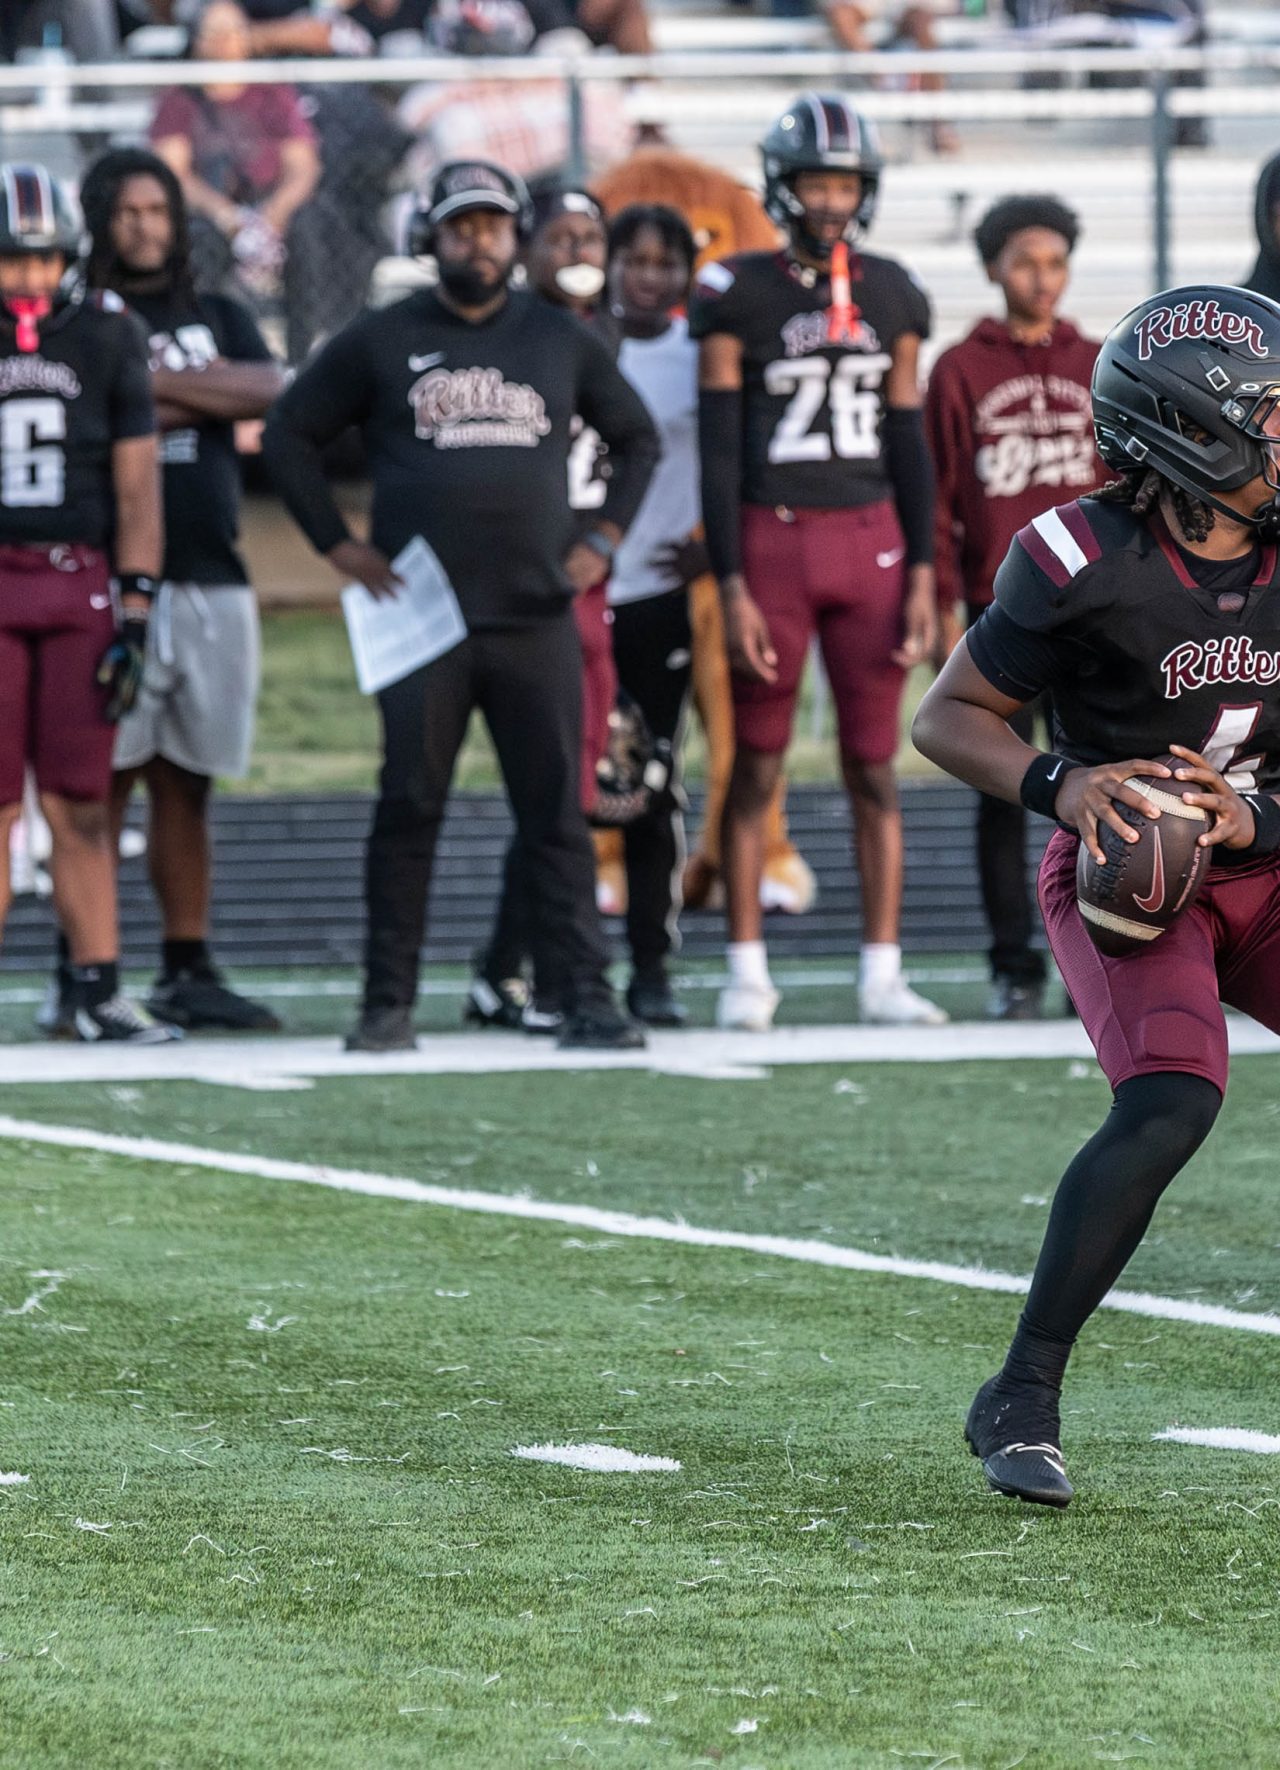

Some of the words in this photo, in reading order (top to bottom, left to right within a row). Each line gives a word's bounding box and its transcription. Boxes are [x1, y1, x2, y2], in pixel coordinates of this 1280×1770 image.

[1134, 300, 1268, 360] Ritter
[408, 366, 551, 440] Ritter
[764, 354, 892, 463] 26
[0, 397, 66, 507] 6
